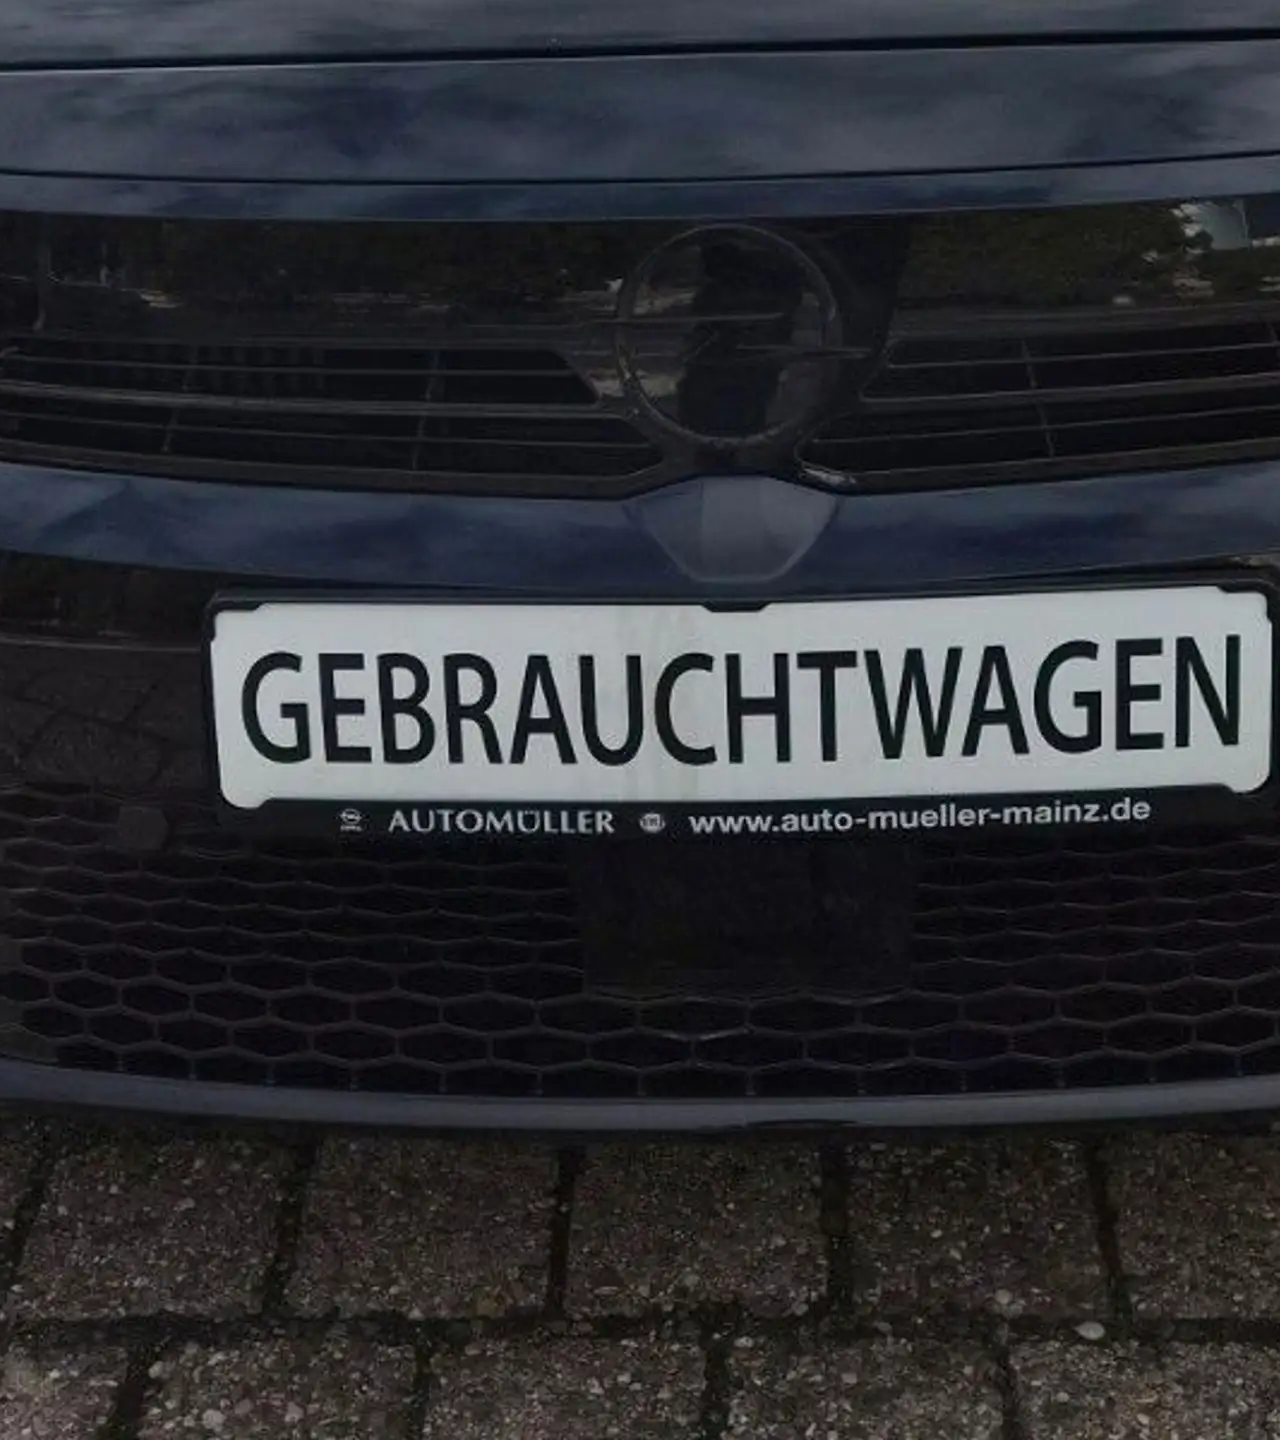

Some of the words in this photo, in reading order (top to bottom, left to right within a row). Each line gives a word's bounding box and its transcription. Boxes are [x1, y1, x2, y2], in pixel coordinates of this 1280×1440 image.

[240, 634, 1242, 766] GEBRAUCHTWAGEN
[387, 807, 616, 834] AUTOMÜLLER
[687, 796, 1152, 835] www.auto-mueller-mainz.de
